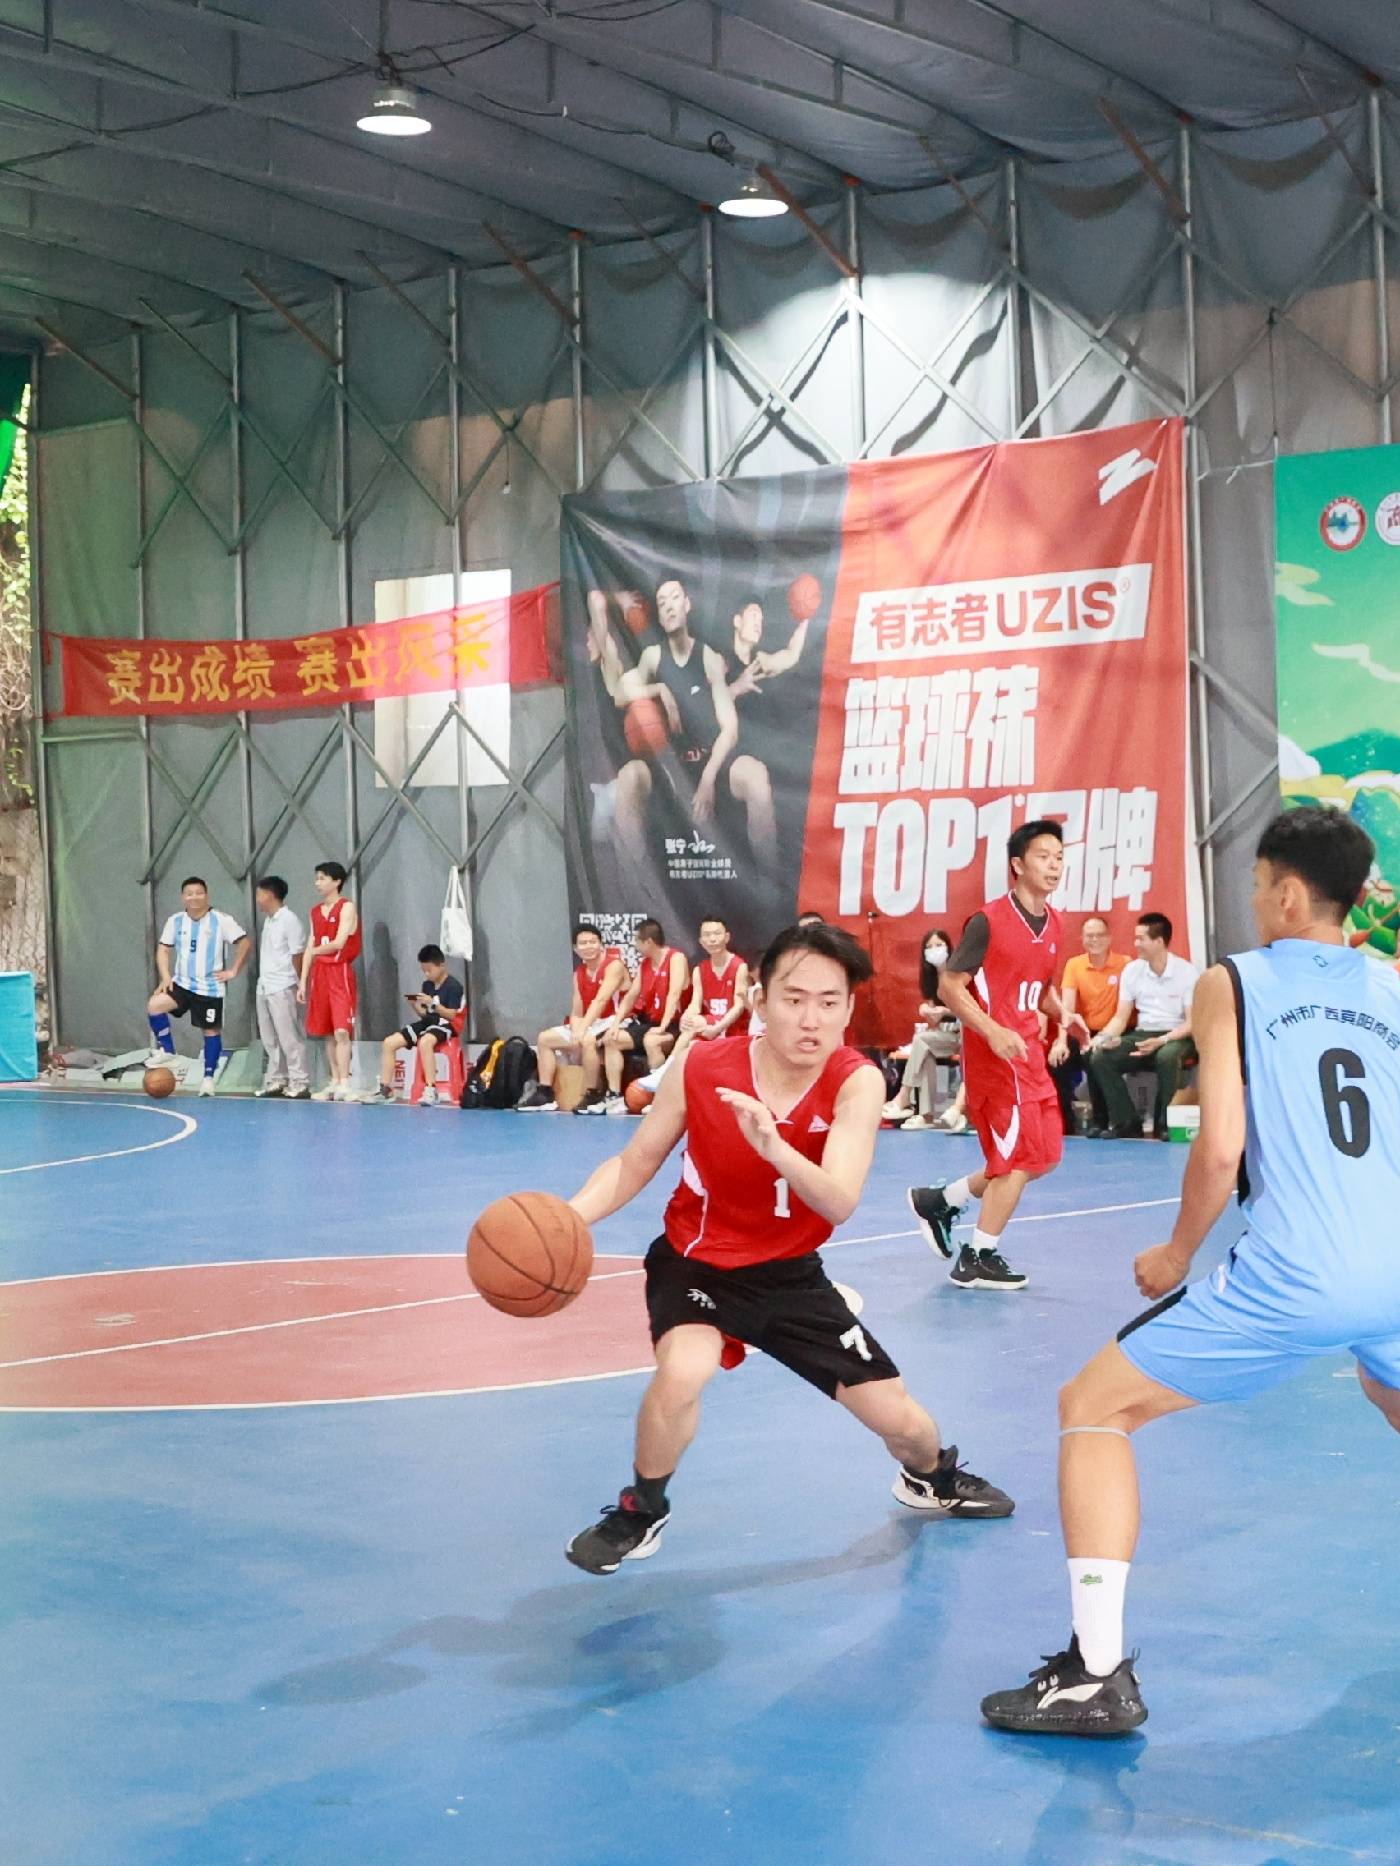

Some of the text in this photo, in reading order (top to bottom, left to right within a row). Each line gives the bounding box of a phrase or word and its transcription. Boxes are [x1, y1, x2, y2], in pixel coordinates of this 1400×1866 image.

[105, 643, 277, 704] 赛出成绩
[838, 664, 1039, 794] 篮球袜
[206, 1008, 216, 1023] 9
[1017, 981, 1042, 1012] 10
[1319, 1047, 1371, 1158] 6
